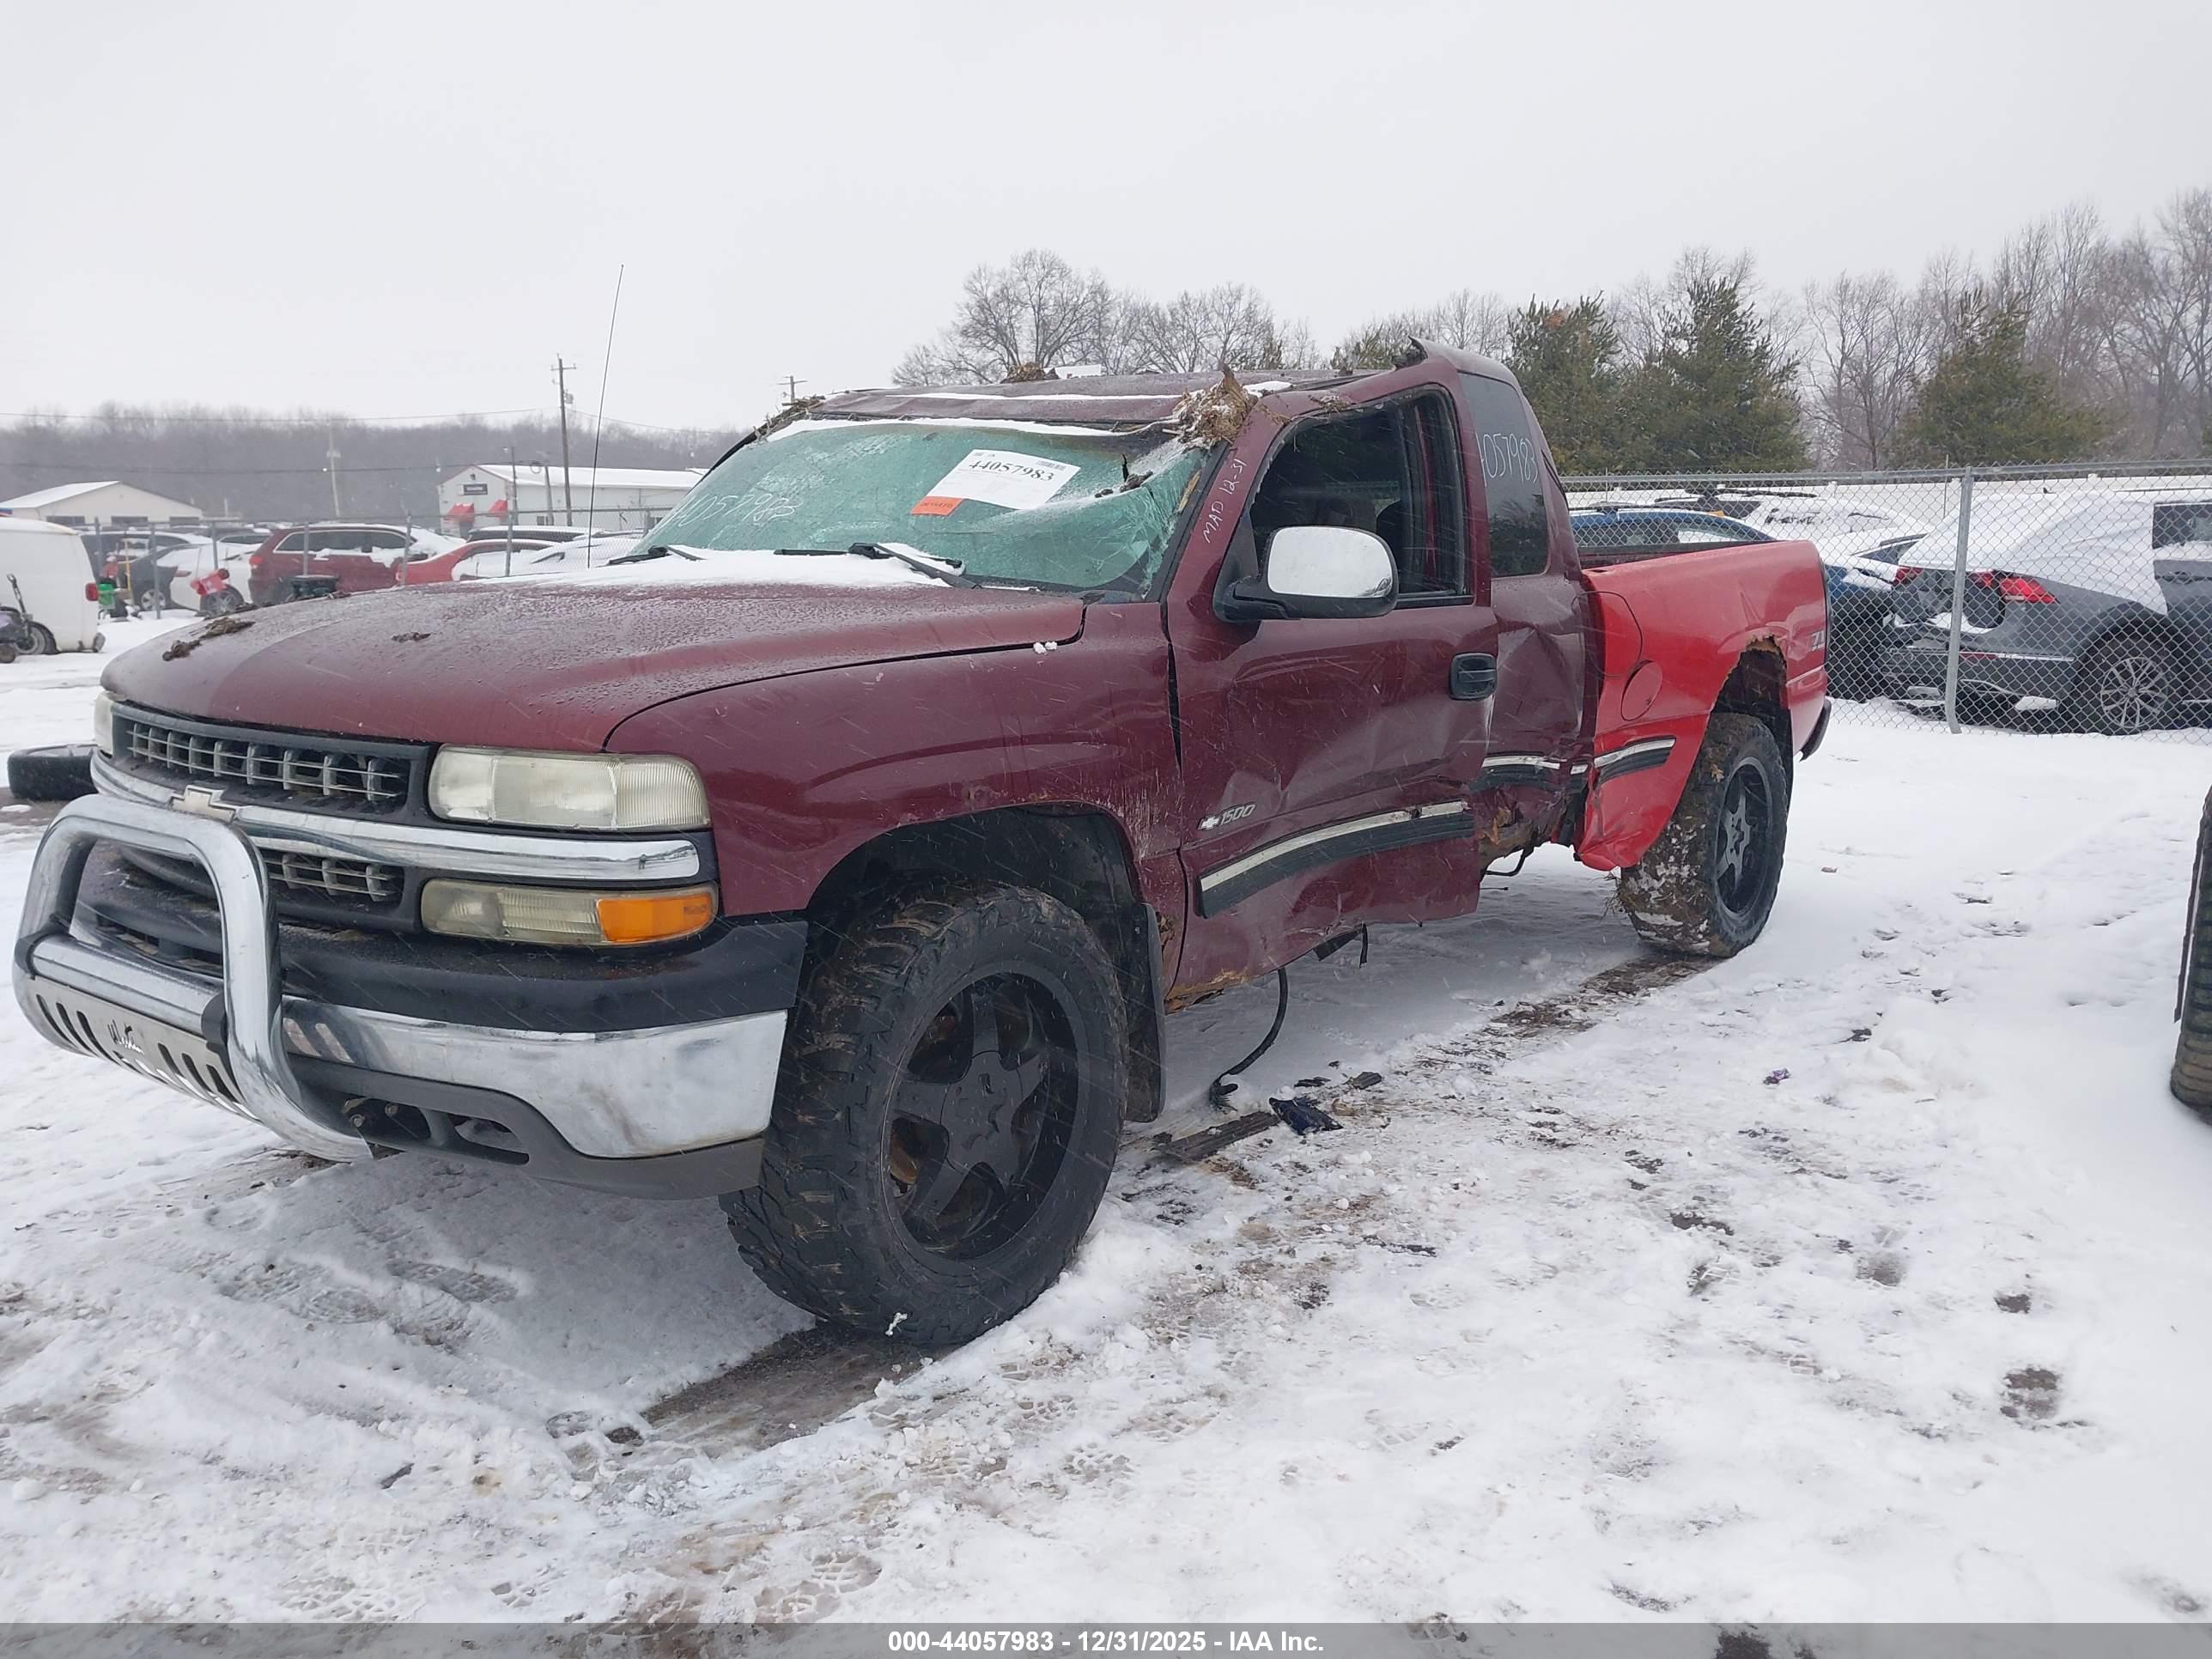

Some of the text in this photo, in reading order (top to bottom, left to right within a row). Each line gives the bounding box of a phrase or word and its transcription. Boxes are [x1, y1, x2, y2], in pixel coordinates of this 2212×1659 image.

[969, 459, 1054, 482] 44057983
[1203, 459, 1248, 543] MAD 12-31
[1220, 804, 1256, 825] 1500
